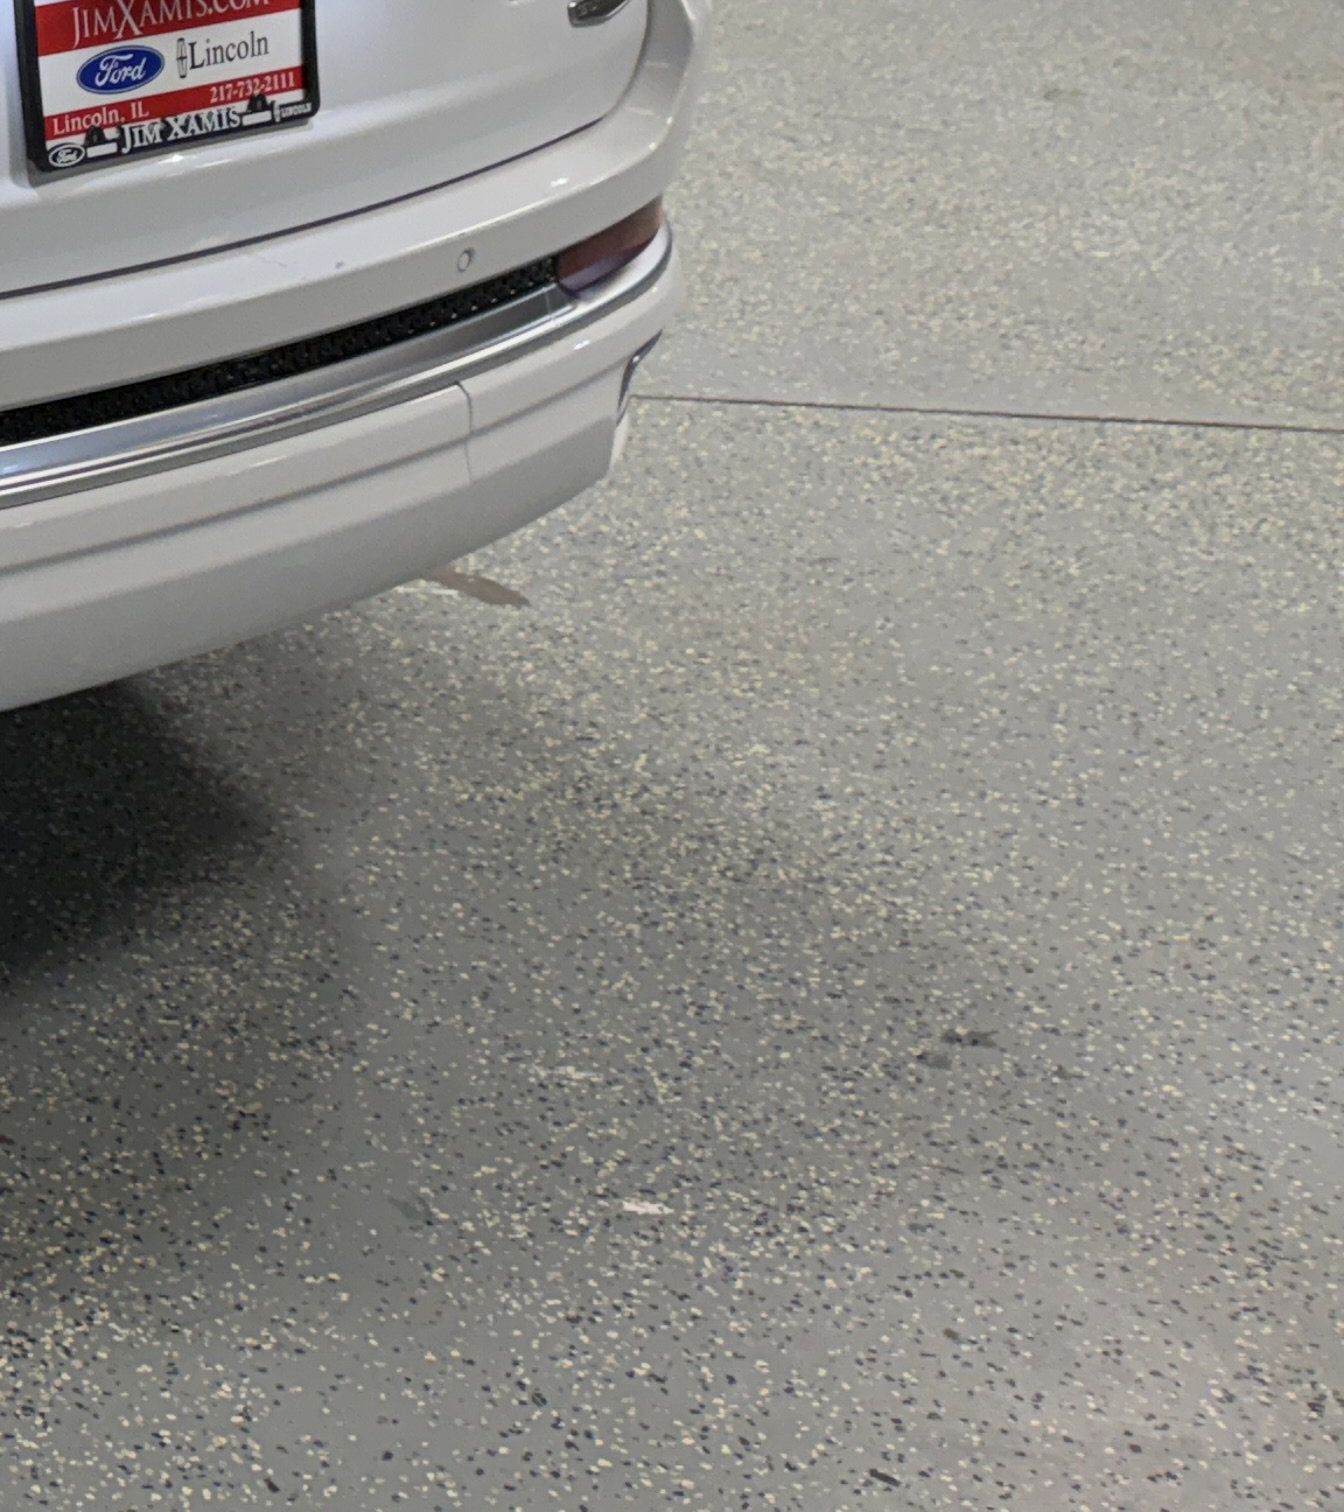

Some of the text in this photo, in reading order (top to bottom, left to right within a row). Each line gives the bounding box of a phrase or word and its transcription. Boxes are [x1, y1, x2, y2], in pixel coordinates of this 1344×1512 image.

[94, 30, 270, 87] Ford Lincoln
[210, 71, 296, 104] 217-732-2111
[130, 101, 150, 119] IL
[122, 107, 243, 155] JIM XAMIS
